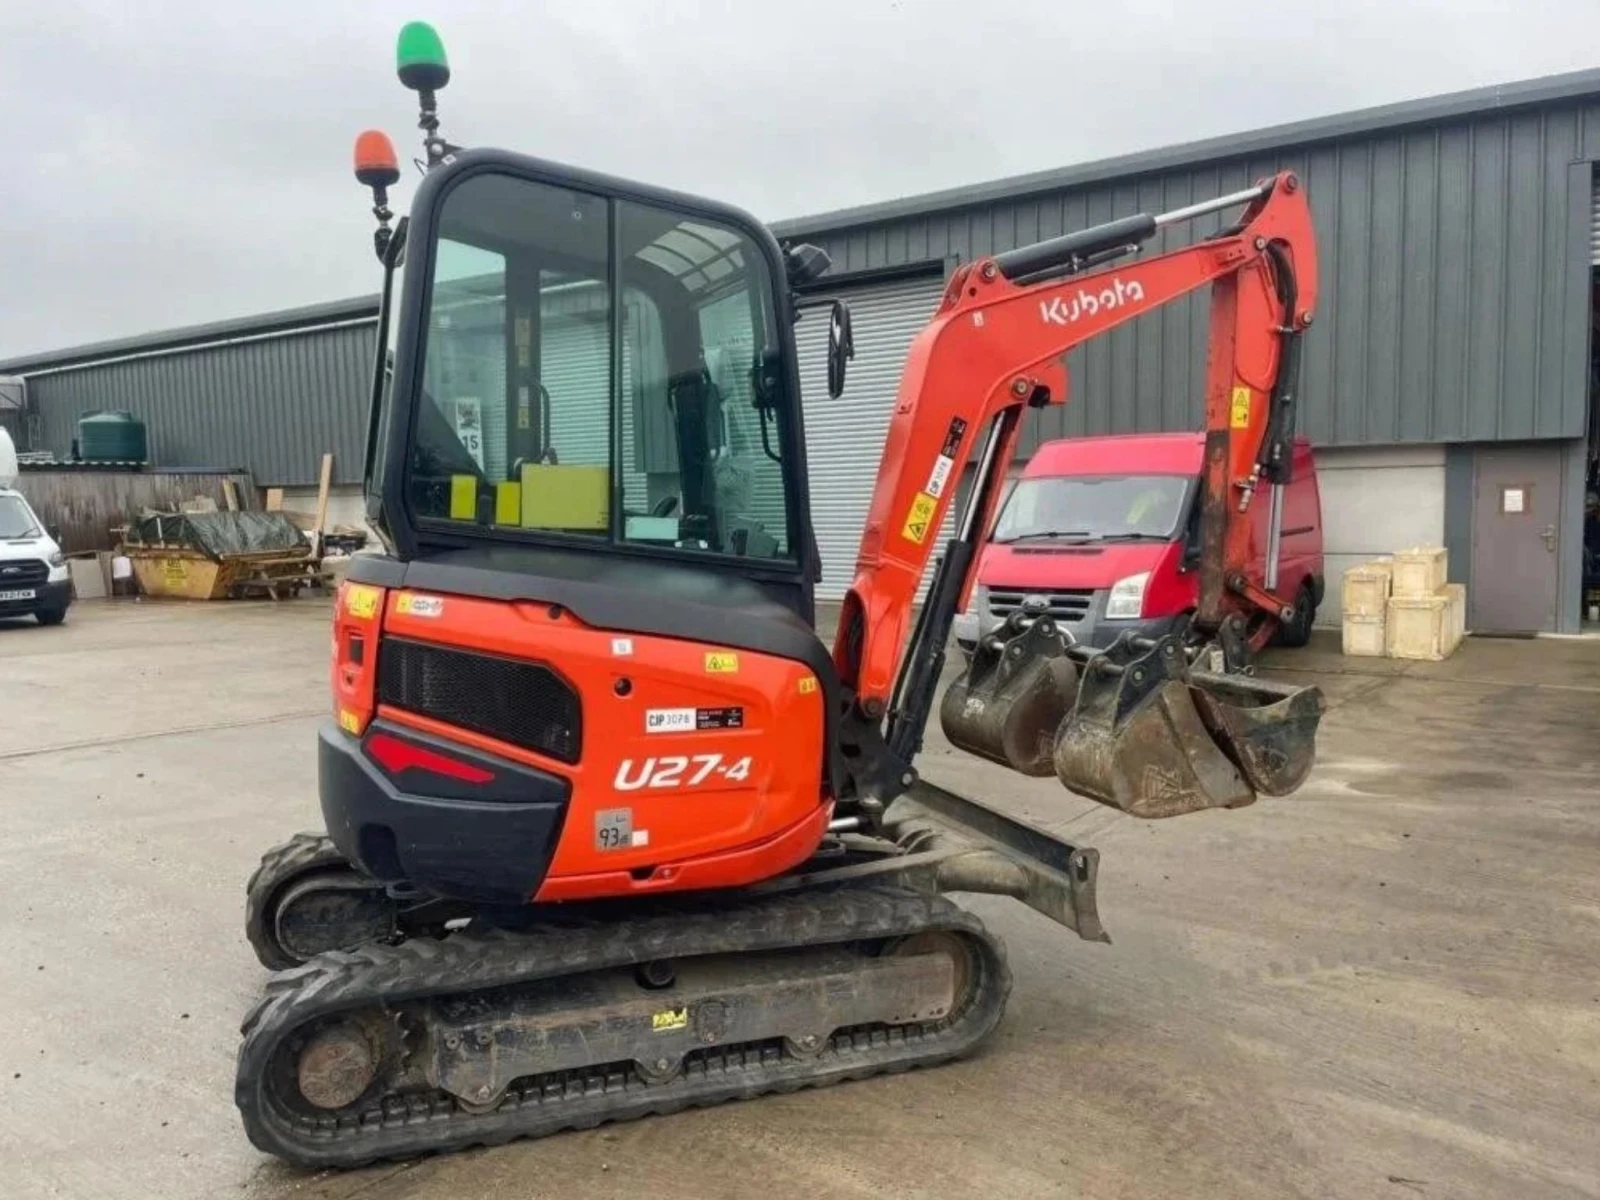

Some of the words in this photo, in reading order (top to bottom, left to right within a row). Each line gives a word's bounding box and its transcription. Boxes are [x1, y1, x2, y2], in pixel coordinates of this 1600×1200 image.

[1040, 278, 1144, 326] Kubota
[648, 714, 664, 726] CJP
[614, 753, 752, 790] U27-4
[599, 827, 619, 848] 93
